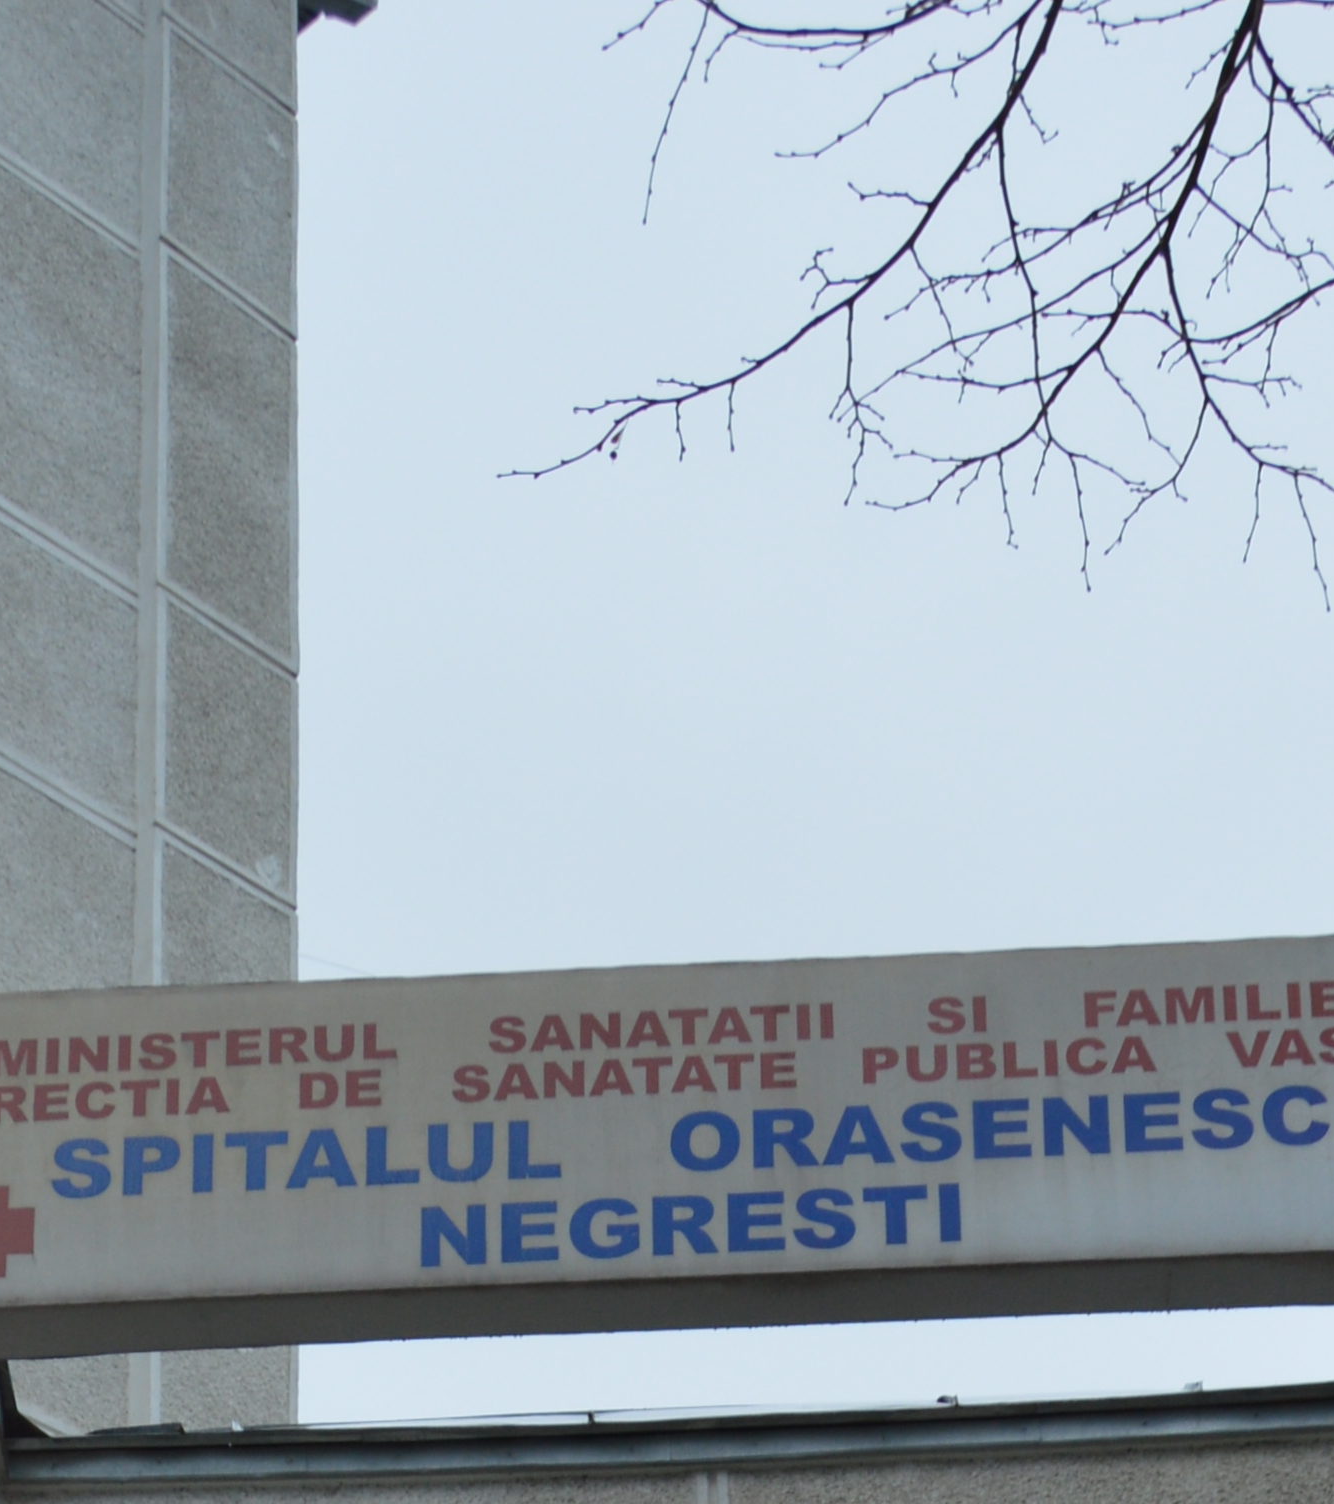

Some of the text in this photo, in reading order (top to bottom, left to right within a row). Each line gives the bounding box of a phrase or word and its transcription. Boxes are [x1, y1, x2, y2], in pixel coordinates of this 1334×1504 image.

[488, 1004, 835, 1054] SANATATII
[927, 997, 987, 1035] SI
[298, 1070, 383, 1111] DE
[452, 1053, 798, 1104] SANATATE
[862, 1036, 1156, 1085] PUBLICA
[50, 1085, 1331, 1200] SPITALUL ORASENESC
[418, 1183, 963, 1270] NEGRESTI
